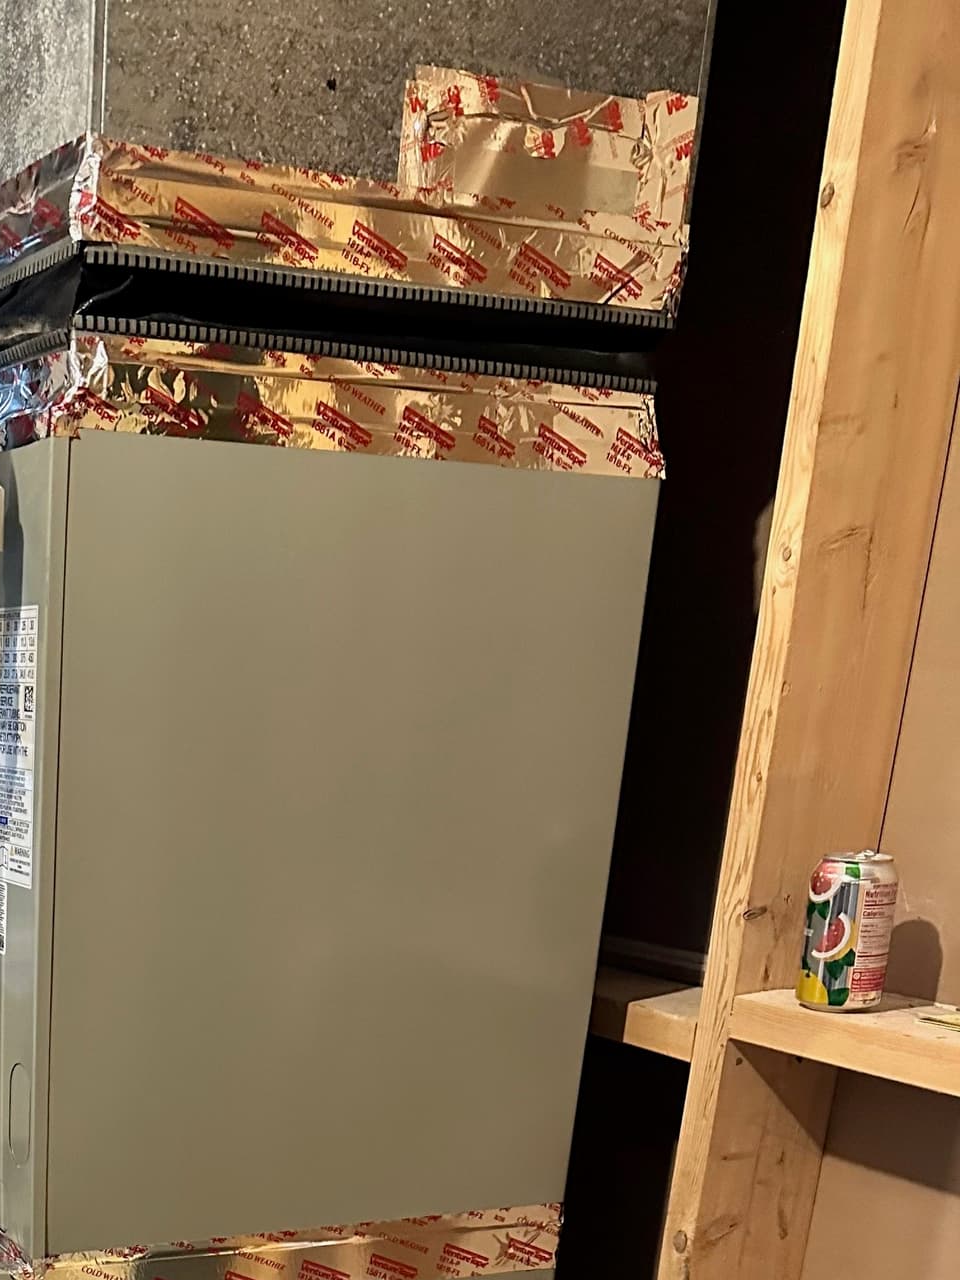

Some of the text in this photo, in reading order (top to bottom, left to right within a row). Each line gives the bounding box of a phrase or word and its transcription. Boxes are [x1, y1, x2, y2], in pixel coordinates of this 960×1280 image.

[272, 183, 335, 230] COLD WEATHER
[341, 249, 371, 274] 181B-FX
[346, 237, 372, 259] 181A-P
[352, 223, 407, 273] VentureTape
[433, 236, 487, 284] VentureTape
[519, 245, 572, 291] VentureTape
[351, 387, 387, 417] WEATHER
[316, 404, 373, 449] VentureTape
[403, 408, 457, 452] VentureTape
[540, 427, 587, 467] VentureTape
[616, 431, 664, 470] VentureTape
[81, 1265, 103, 1278] COLD
[254, 1257, 286, 1271] WEATHER
[443, 1246, 490, 1269] VentureTape
